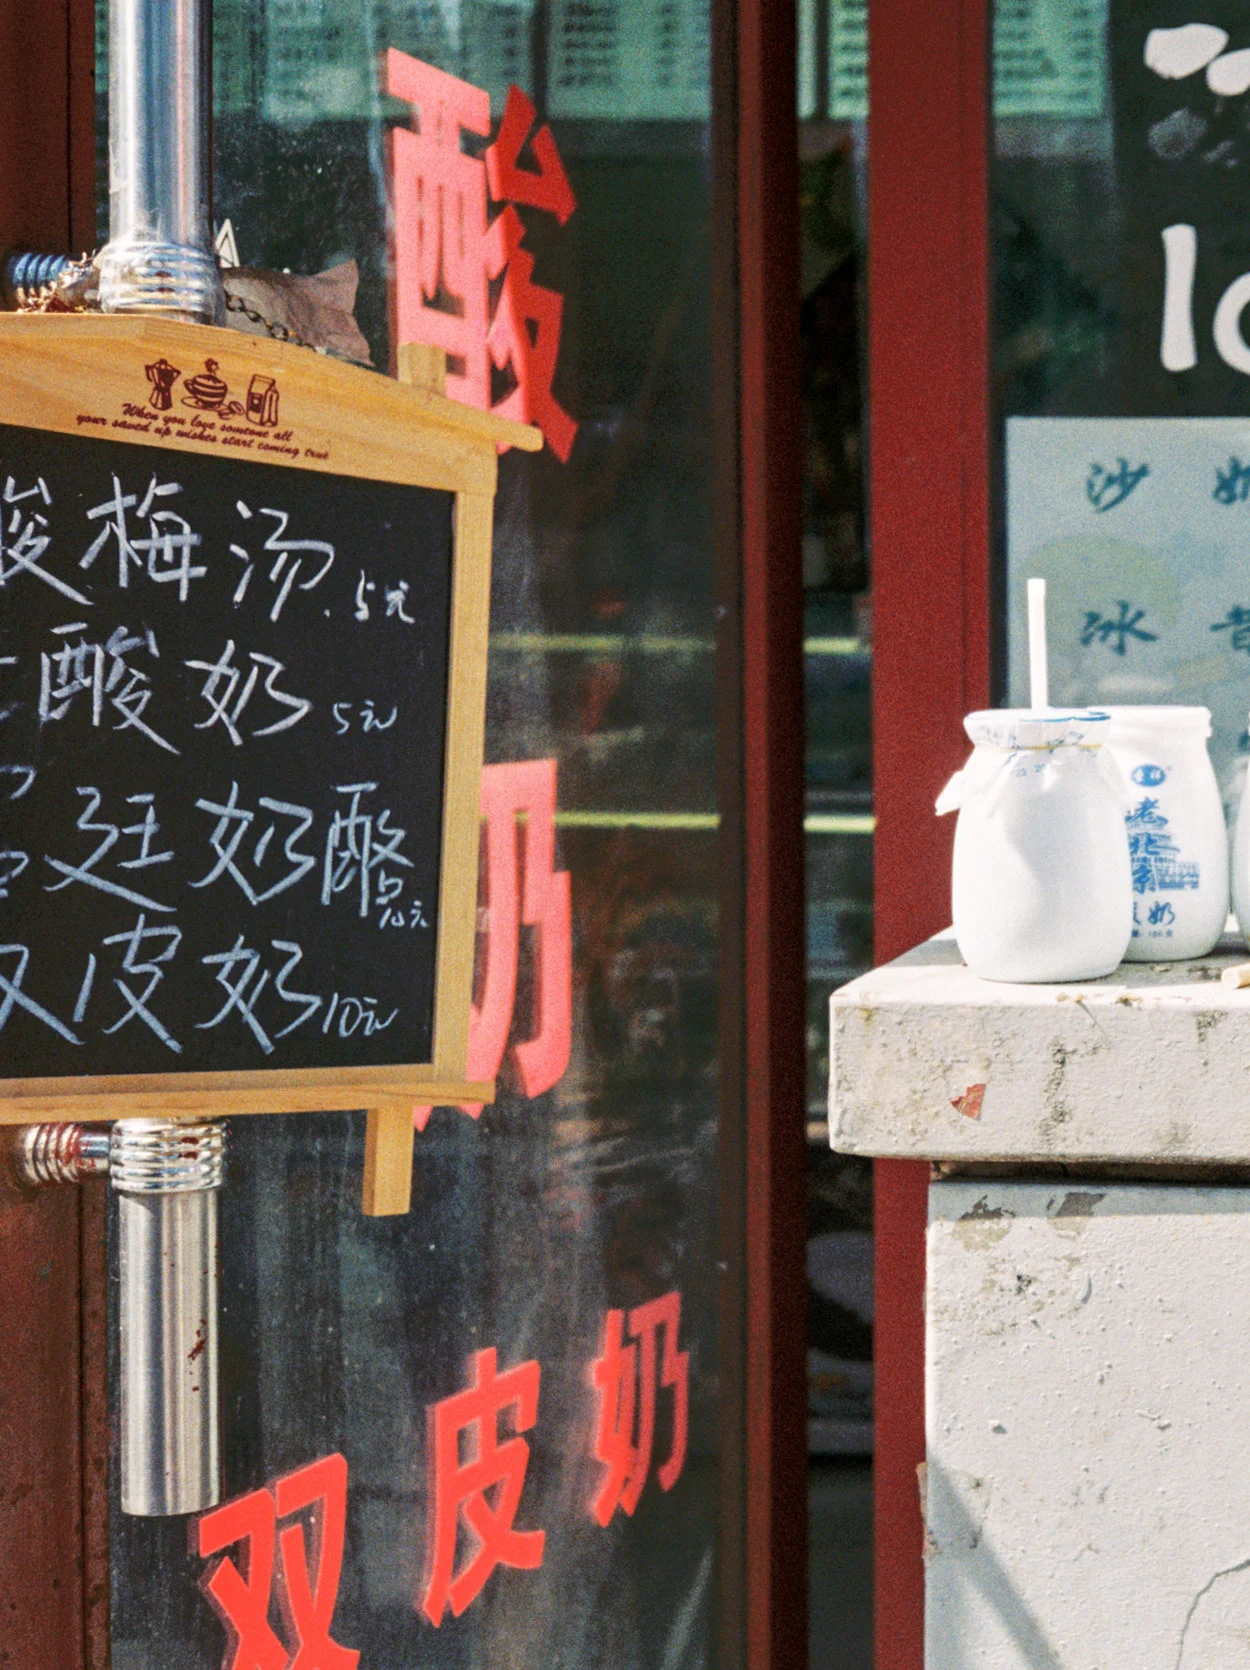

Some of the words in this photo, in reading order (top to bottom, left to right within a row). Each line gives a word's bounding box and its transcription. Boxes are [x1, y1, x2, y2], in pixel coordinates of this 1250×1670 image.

[77, 413, 107, 425] your
[112, 417, 150, 432] saved
[154, 426, 171, 437] up
[176, 429, 217, 443] wishes
[222, 435, 254, 447] start
[258, 442, 299, 457] coming
[304, 448, 329, 460] true
[122, 402, 158, 421] When
[163, 414, 187, 428] you
[190, 414, 215, 430] love
[220, 424, 269, 438] someone
[273, 431, 294, 442] all
[1080, 457, 1158, 656] 沙冰
[0, 622, 313, 755] 酸奶
[1133, 900, 1175, 926] 奶
[198, 1292, 690, 1670] 双皮奶
